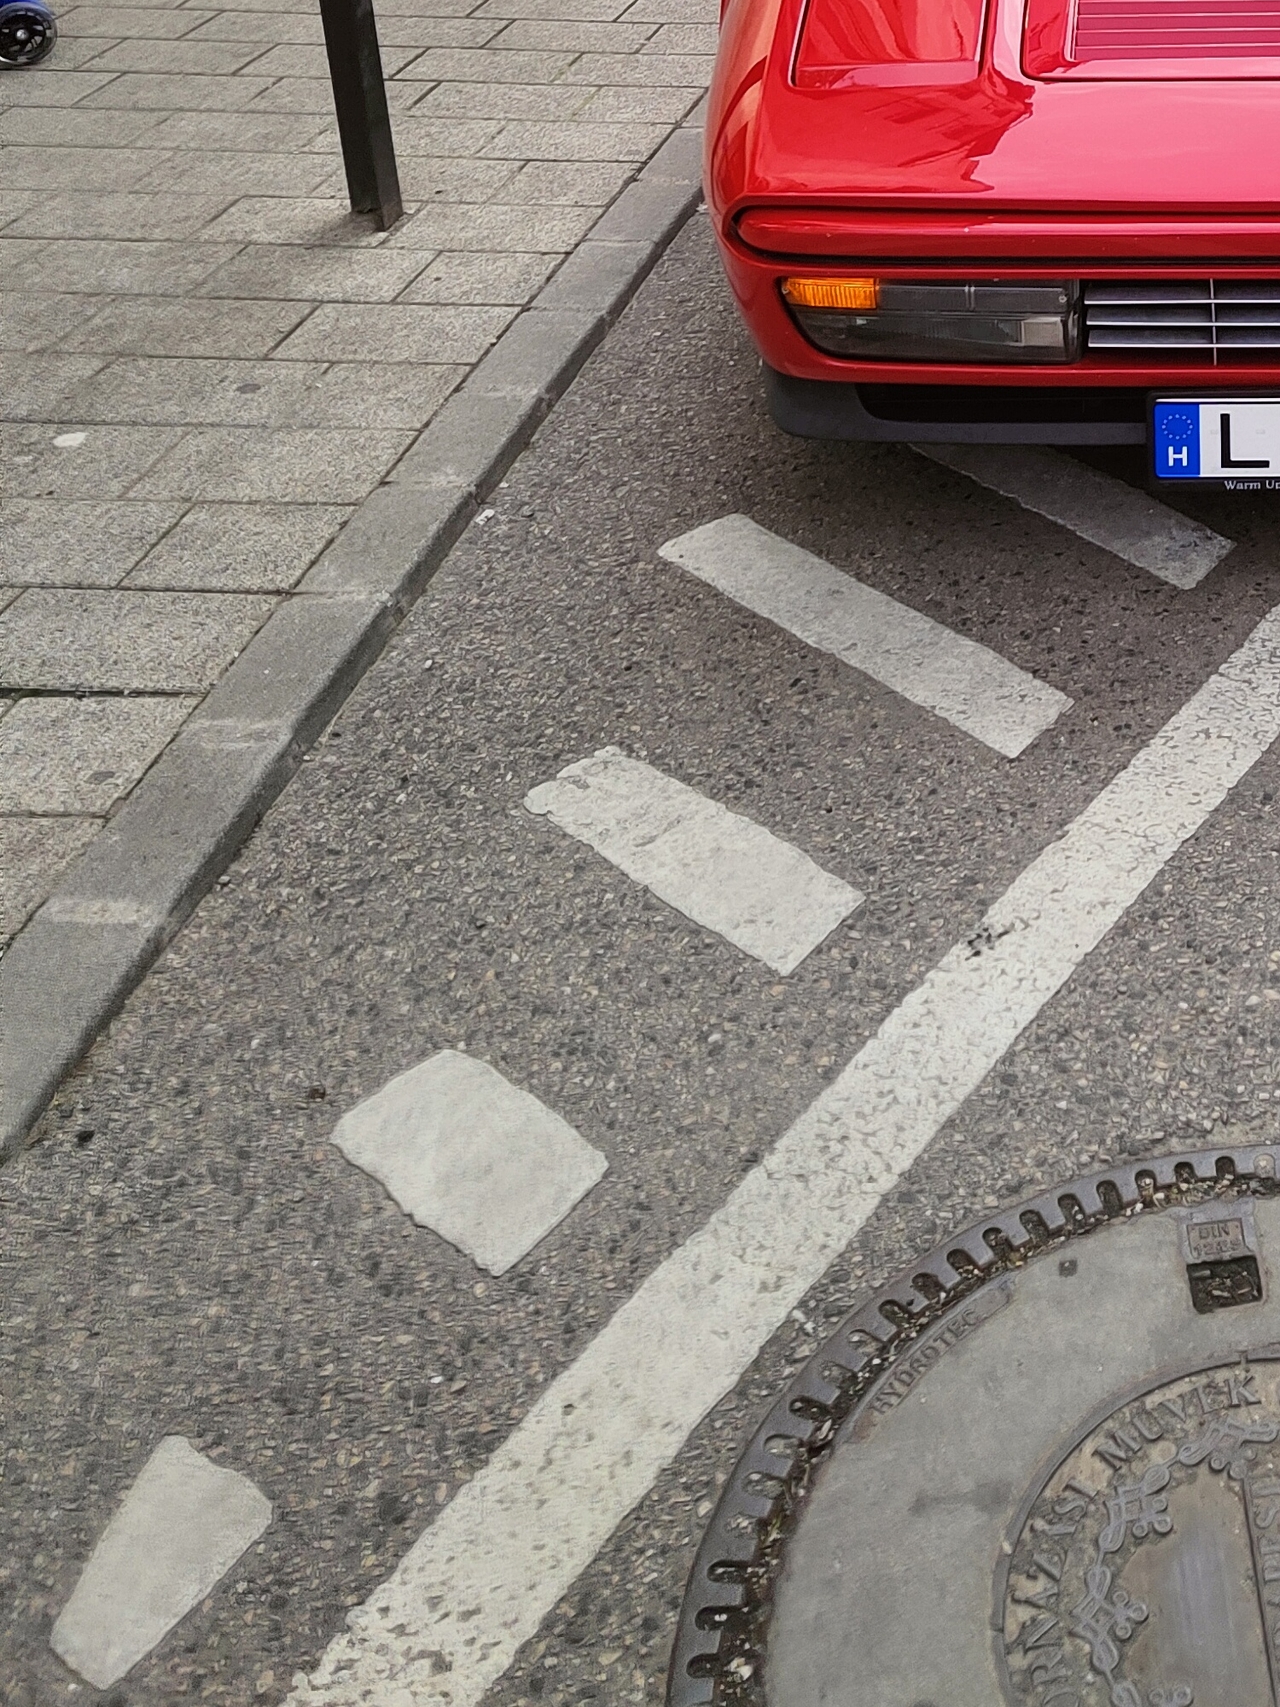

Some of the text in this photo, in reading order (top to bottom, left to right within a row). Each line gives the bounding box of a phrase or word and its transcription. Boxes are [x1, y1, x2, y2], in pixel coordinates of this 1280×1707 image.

[1167, 445, 1189, 467] H
[1223, 480, 1262, 491] Warm
[869, 1308, 979, 1416] HYDROTEC
